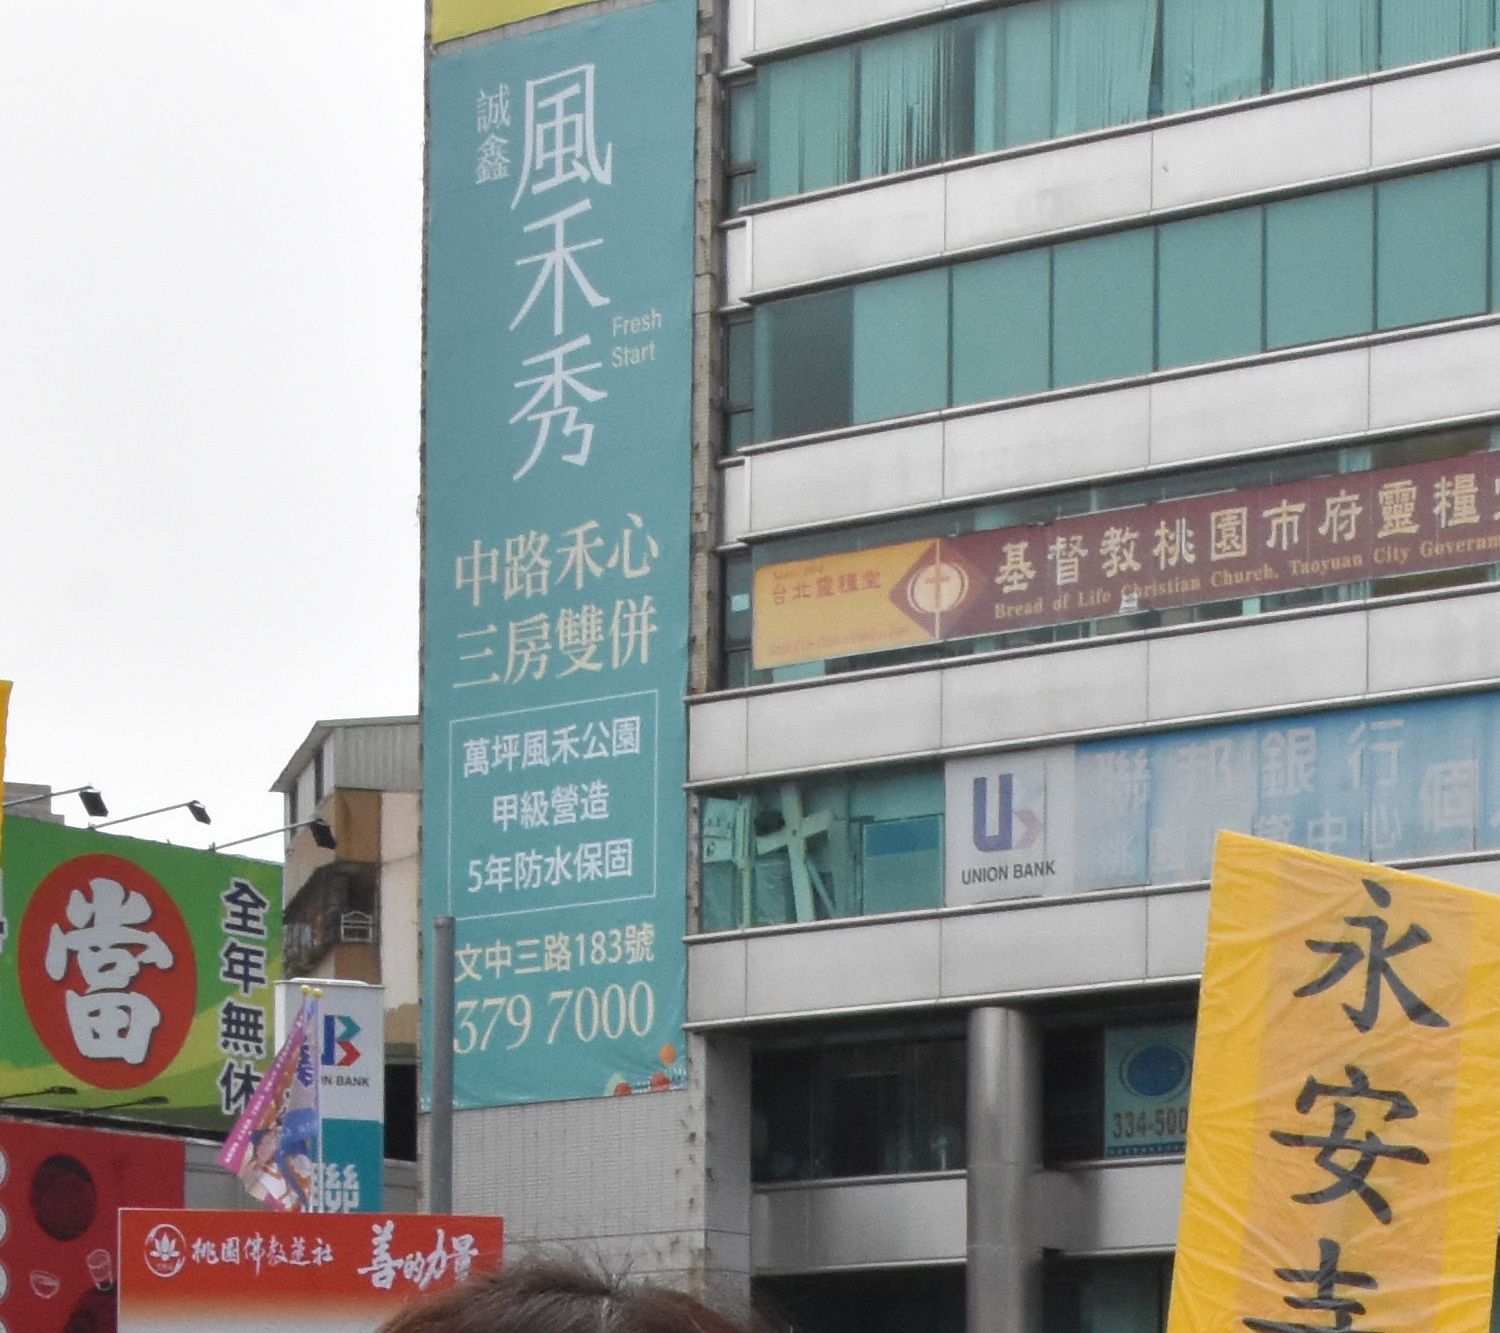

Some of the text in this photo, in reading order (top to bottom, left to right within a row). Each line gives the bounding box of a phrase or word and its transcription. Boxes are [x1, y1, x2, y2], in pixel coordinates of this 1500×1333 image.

[475, 83, 511, 185] 誠鑫
[510, 63, 613, 482] 風禾秀
[612, 308, 662, 338] Fresh
[612, 342, 656, 369] Start
[455, 512, 660, 607] 中路禾心
[994, 601, 1044, 620] Bread
[1053, 596, 1072, 613] of
[1079, 589, 1111, 609] Life
[1121, 577, 1200, 601] Christian
[1290, 555, 1364, 582] Taoyuan
[1373, 545, 1410, 566] City
[453, 595, 659, 689] 三房雙併
[462, 715, 642, 778] 萬坪風禾公園
[492, 779, 610, 833] 甲級營造
[467, 837, 634, 894] 5年防水保固
[961, 860, 1056, 886] UNION BANK
[45, 876, 174, 1066] 當
[452, 921, 656, 984] 文中三路183號
[220, 876, 268, 1115] 全年無休
[452, 980, 656, 1057] 379 7000
[334, 1074, 370, 1088] BANK
[357, 1219, 479, 1290] 善的力量
